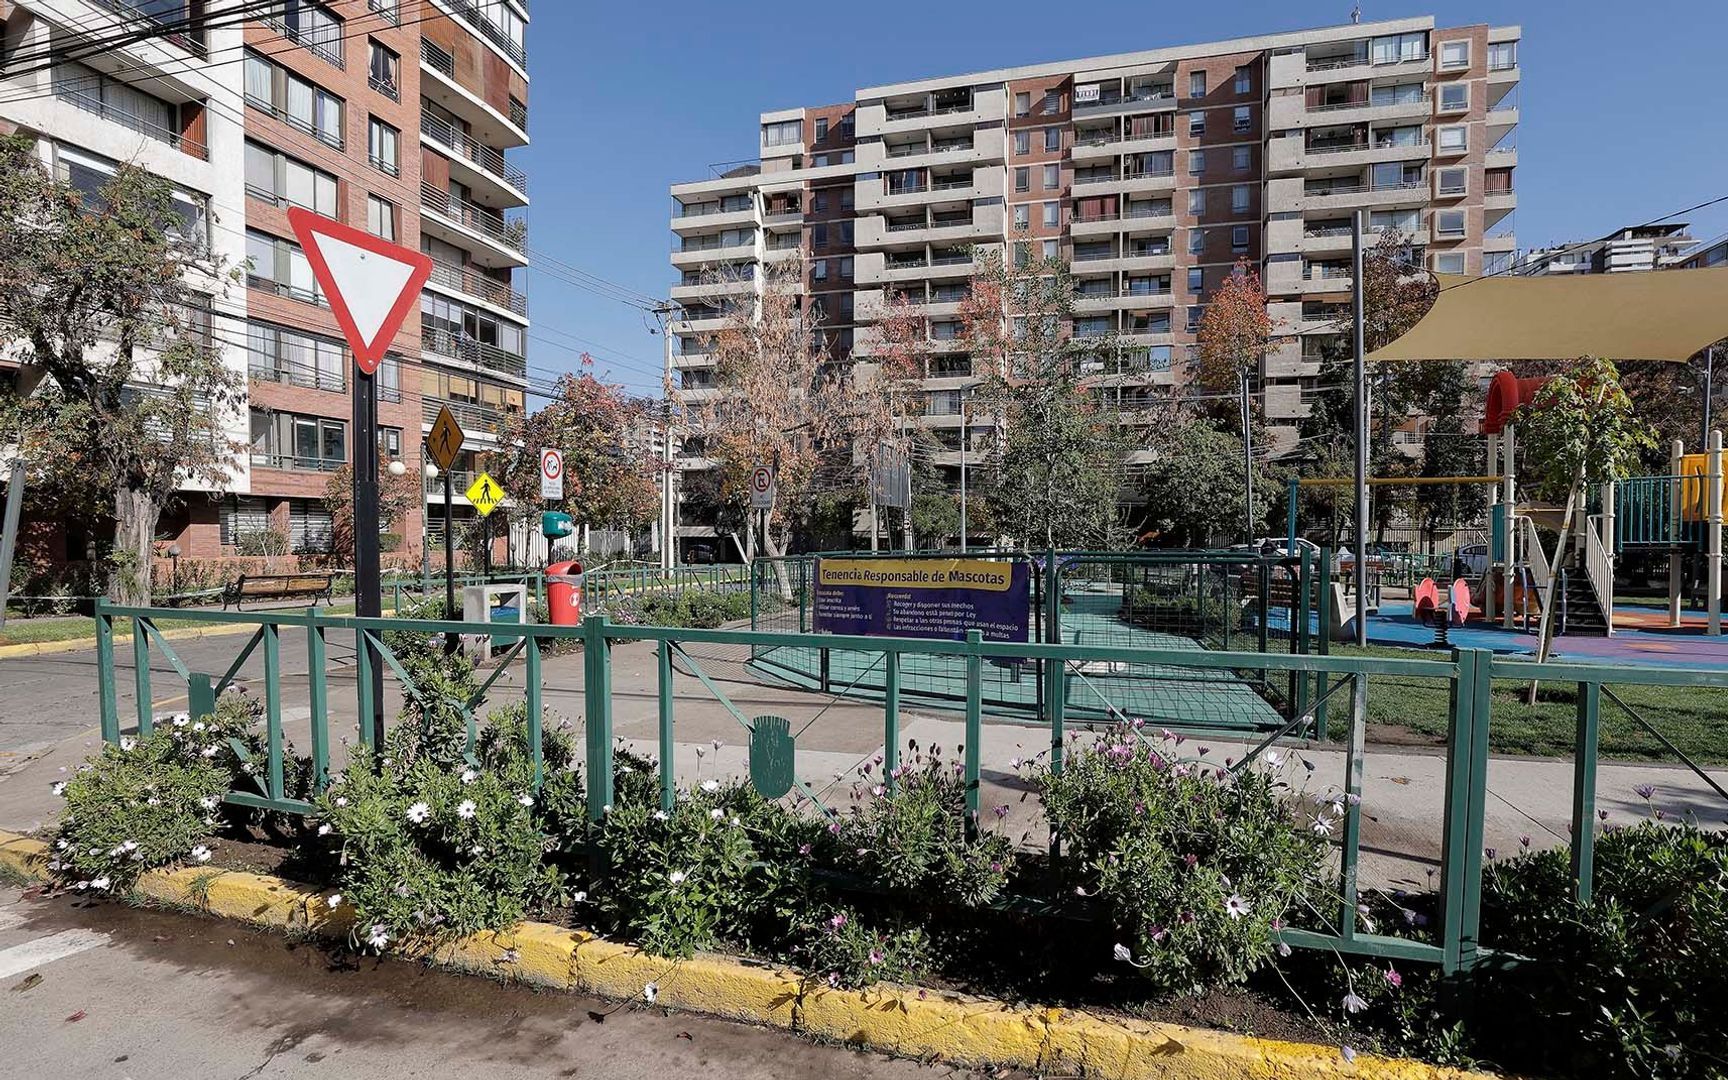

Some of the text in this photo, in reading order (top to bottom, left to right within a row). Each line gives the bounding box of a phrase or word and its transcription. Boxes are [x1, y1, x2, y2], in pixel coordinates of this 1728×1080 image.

[822, 568, 1004, 584] Tenencia Responsable de Mascotas
[966, 611, 976, 619] Ley
[902, 624, 934, 632] infracciones
[991, 631, 1009, 639] multas
[997, 624, 1018, 632] espacio
